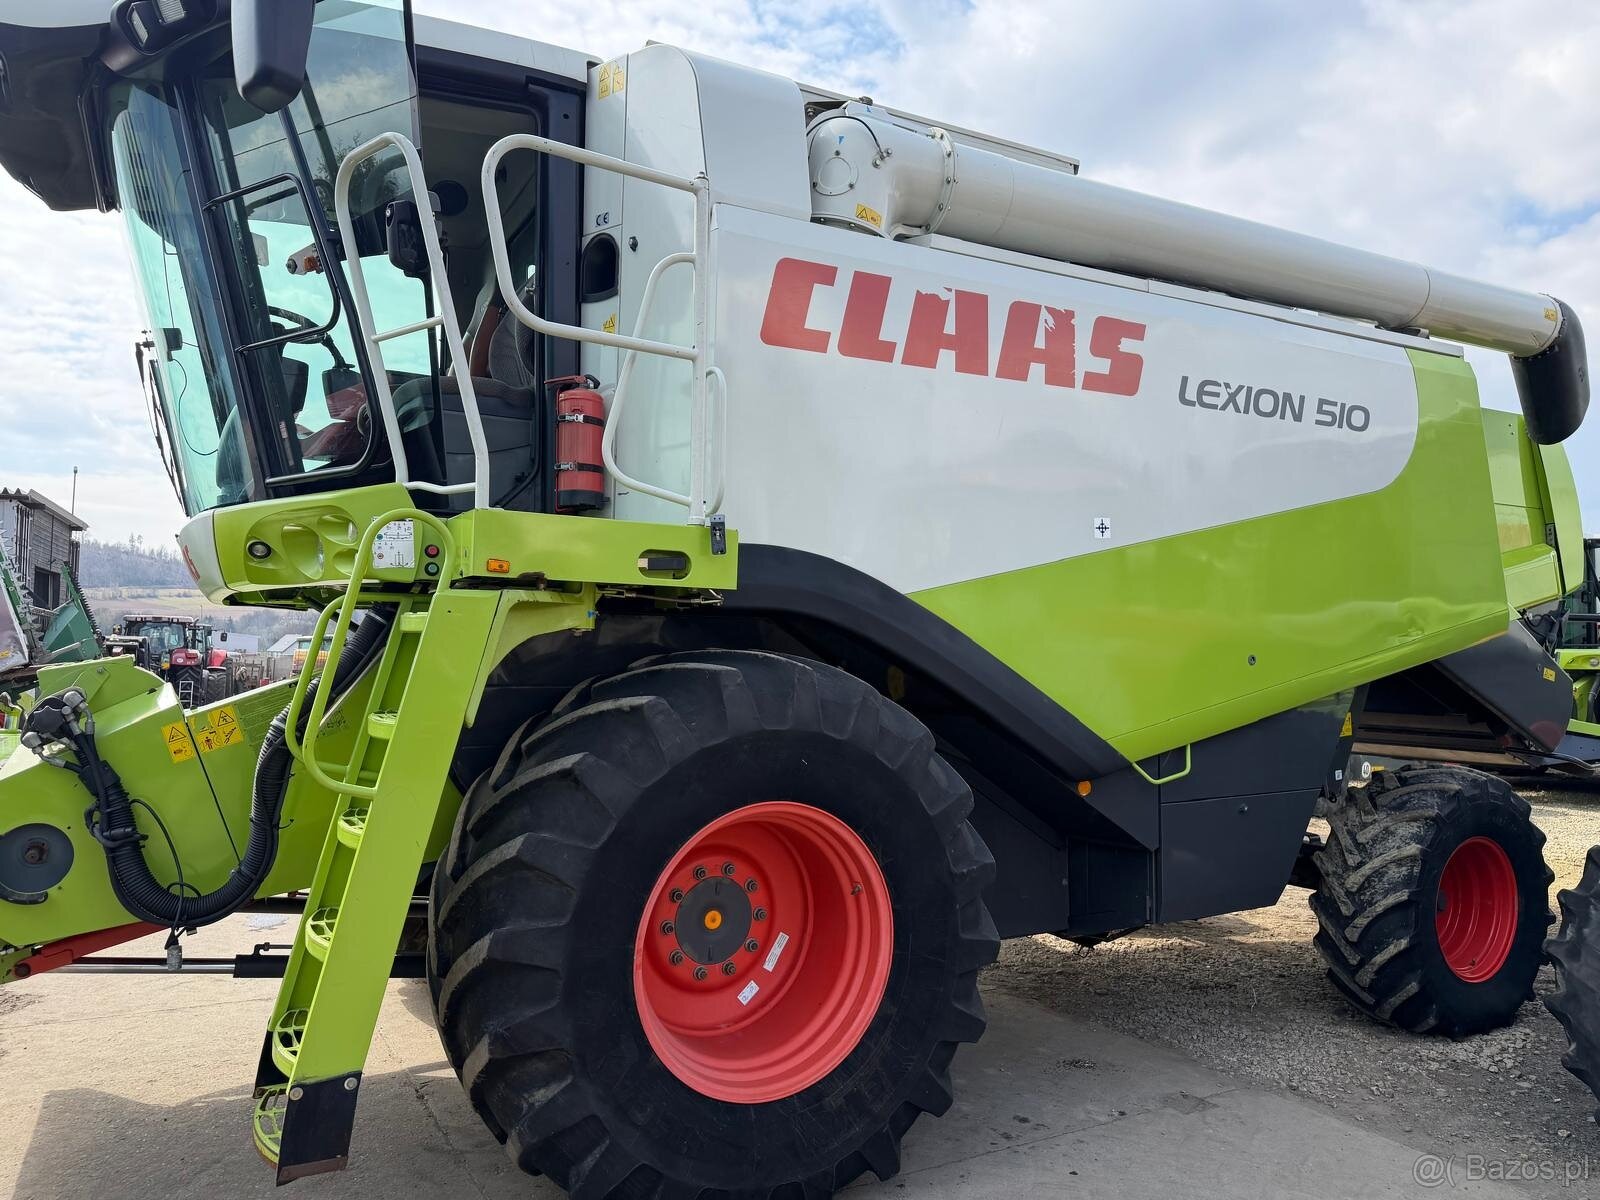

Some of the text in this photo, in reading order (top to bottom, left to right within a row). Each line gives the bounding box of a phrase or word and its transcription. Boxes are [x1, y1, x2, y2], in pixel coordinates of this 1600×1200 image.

[596, 211, 609, 226] CE
[760, 257, 1147, 397] CLAAS
[1178, 375, 1371, 433] LEXION 510
